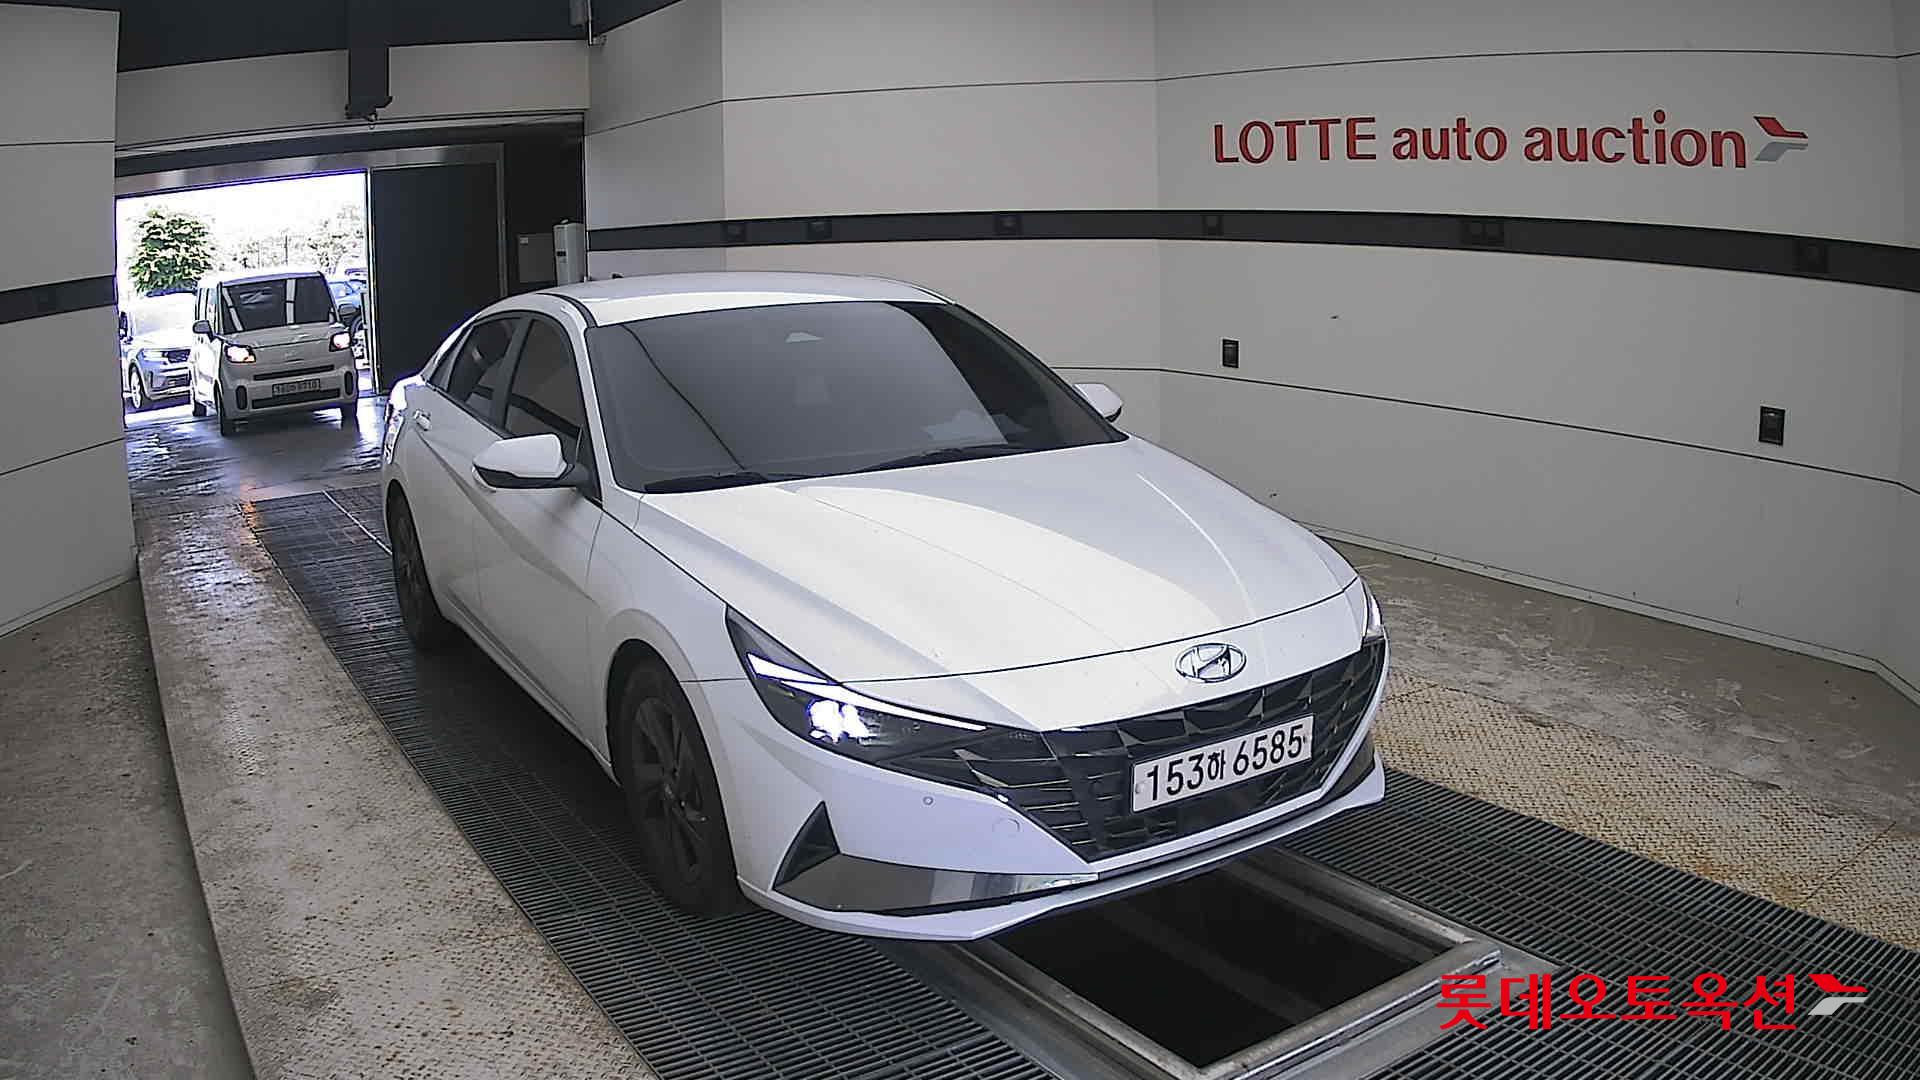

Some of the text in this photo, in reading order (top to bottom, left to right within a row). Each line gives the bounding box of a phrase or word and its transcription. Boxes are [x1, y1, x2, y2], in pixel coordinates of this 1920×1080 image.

[1214, 109, 1747, 168] LOTTE auto auction
[1146, 723, 1304, 801] 153하 6585
